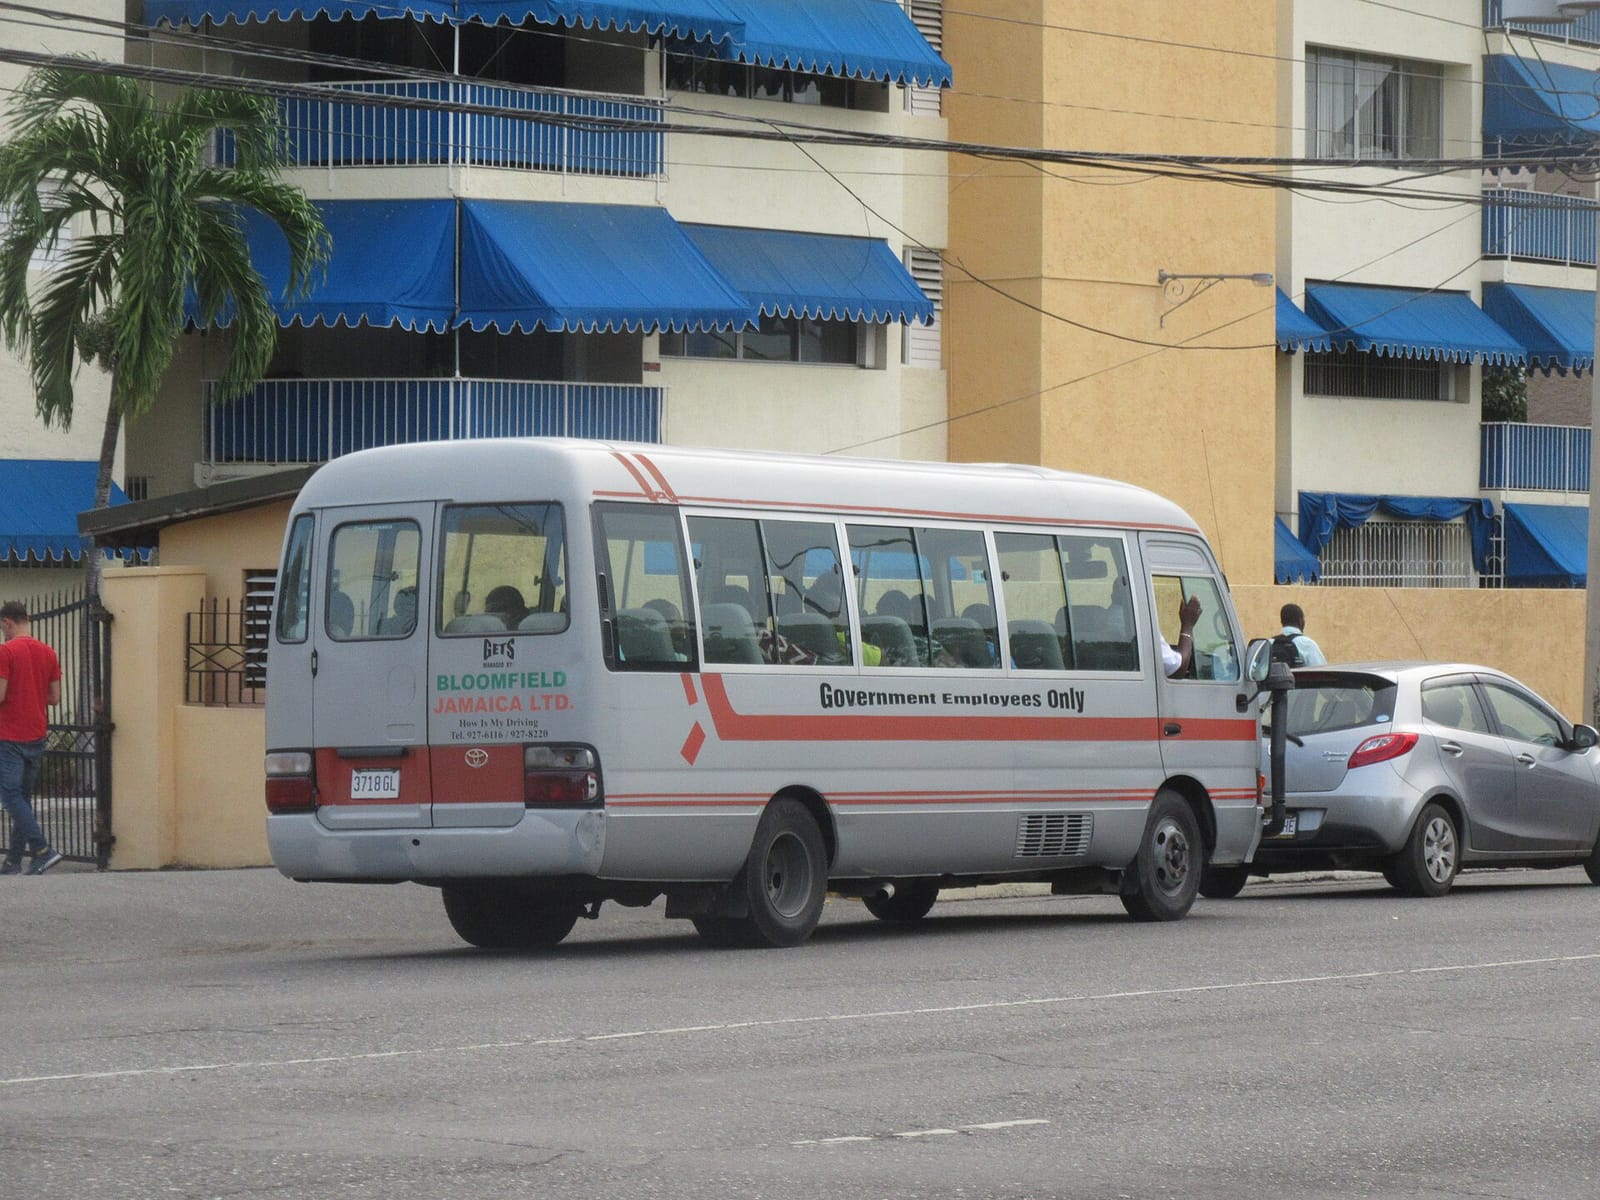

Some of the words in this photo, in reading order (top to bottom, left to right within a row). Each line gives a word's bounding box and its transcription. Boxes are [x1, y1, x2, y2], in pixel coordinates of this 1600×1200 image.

[484, 637, 515, 661] GETS
[437, 671, 567, 691] BLOOMFIELD
[433, 694, 523, 714] JAMAICA
[529, 694, 575, 711] LTD.
[820, 682, 936, 709] Government
[942, 691, 1042, 707] Employees
[1047, 687, 1085, 713] Only
[459, 719, 478, 728] How
[480, 719, 488, 728] Is
[490, 719, 504, 729] My
[506, 718, 538, 729] Driving
[451, 731, 465, 740] Tel.
[510, 729, 549, 739] 927-8220
[354, 775, 381, 792] 3718
[383, 775, 397, 792] GL
